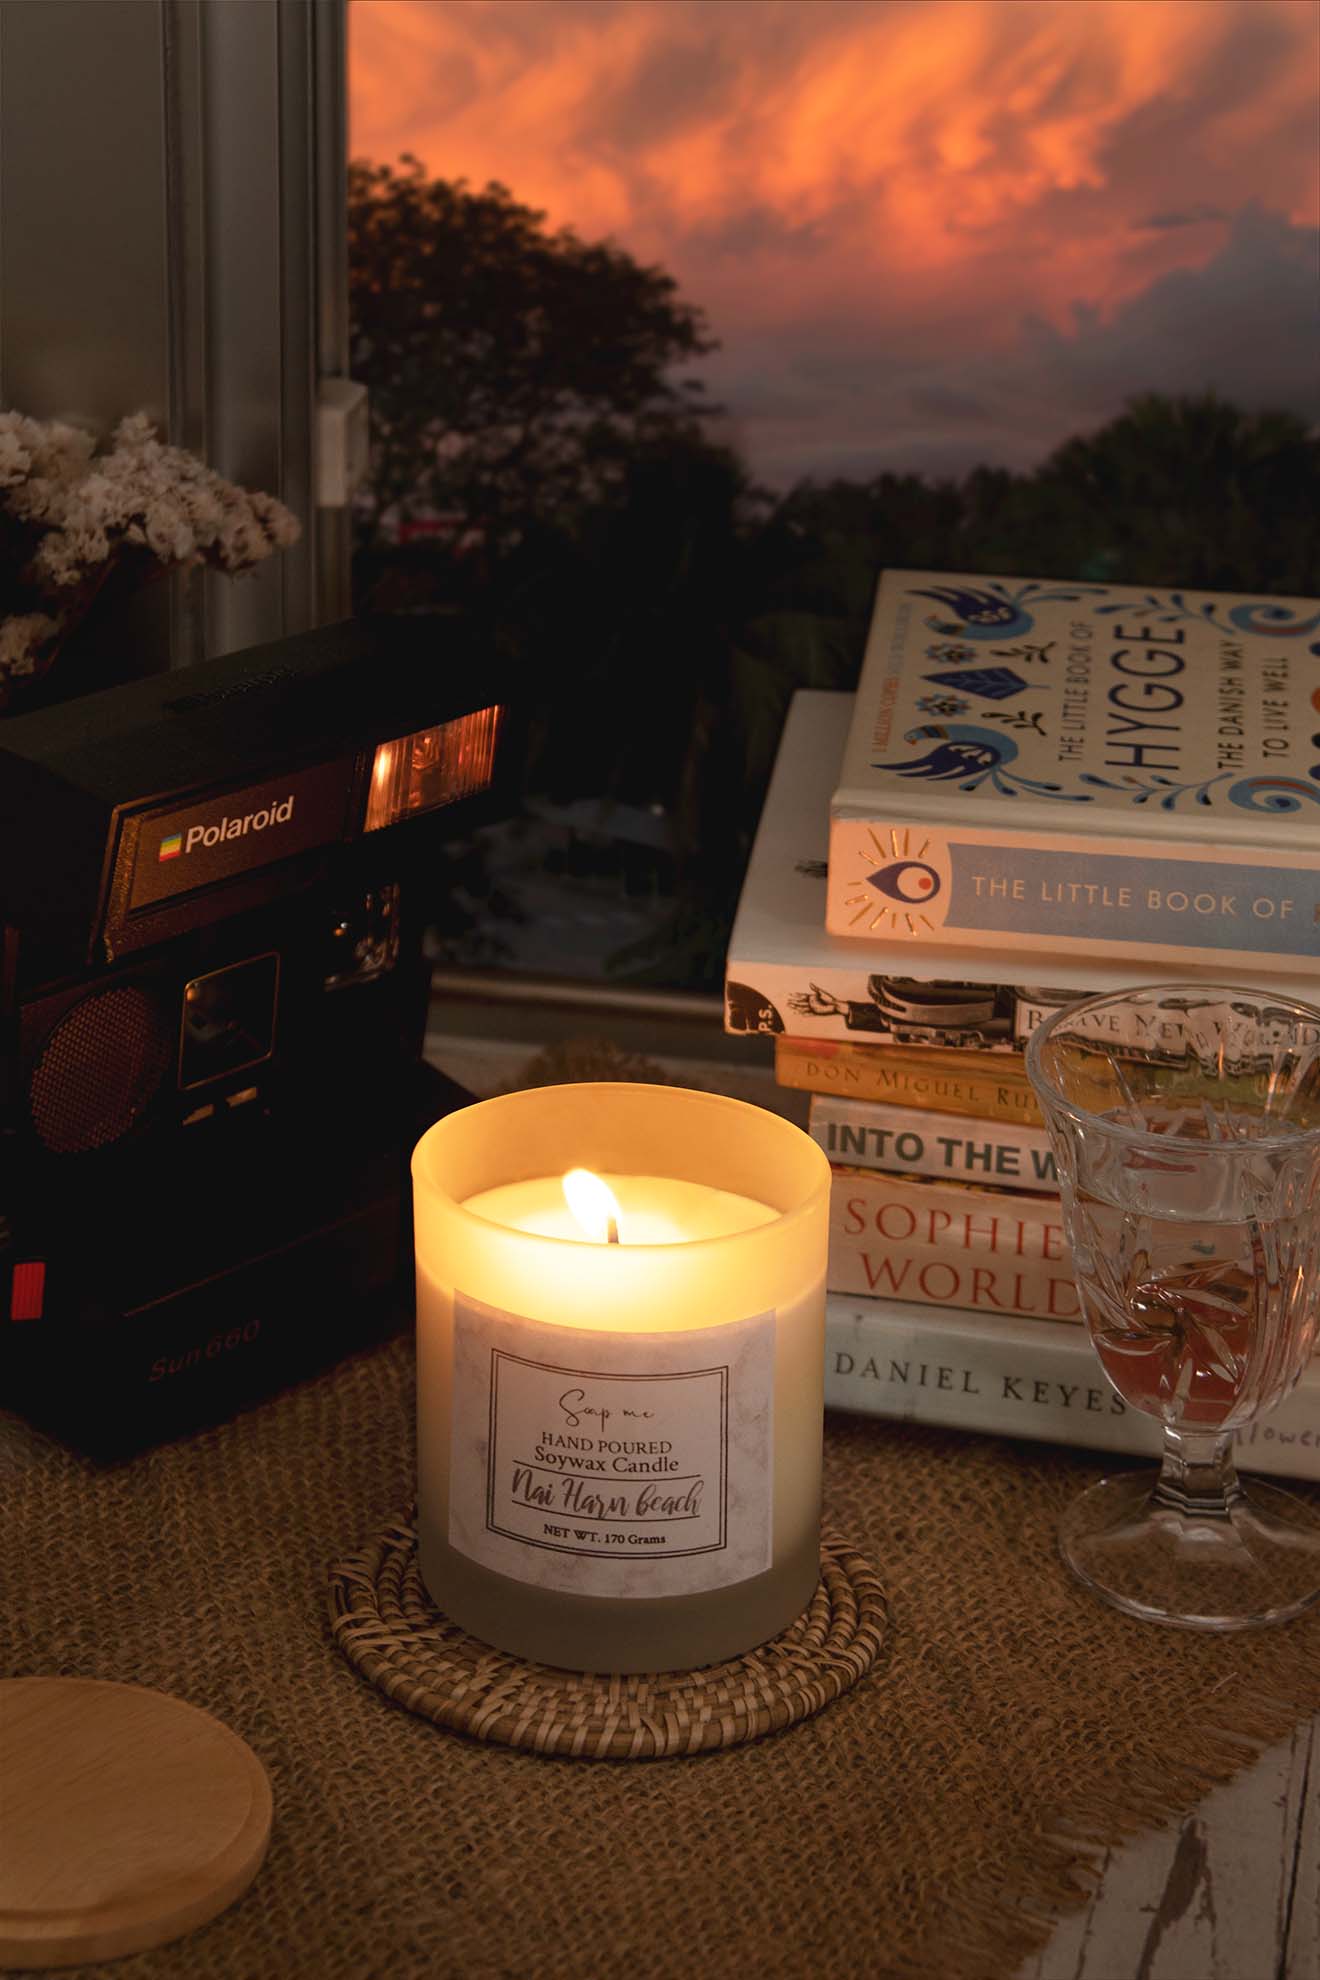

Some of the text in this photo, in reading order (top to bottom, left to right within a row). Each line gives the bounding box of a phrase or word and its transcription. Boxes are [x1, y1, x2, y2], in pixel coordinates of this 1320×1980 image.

[1058, 620, 1095, 762] THE LITTLE BOOK OF
[1104, 624, 1187, 771] HYGGE
[1217, 639, 1246, 770] THE DANISH WAY
[1262, 656, 1290, 759] TO LIVE WELL
[184, 796, 295, 854] Polaroid
[971, 876, 1025, 901] THE
[1041, 881, 1132, 908] LITTLE
[1147, 889, 1236, 918] BOOK
[1252, 897, 1294, 919] OF
[806, 1062, 860, 1082] DON
[876, 1069, 979, 1102] MIGUEL
[827, 1122, 925, 1162] INTO
[936, 1136, 1021, 1176] THE
[860, 1252, 1081, 1316] WORLD
[559, 1388, 655, 1432] Soap me
[834, 1351, 1127, 1416] DANIEL KEYES
[534, 1446, 680, 1474] Soywax Candle
[541, 1431, 673, 1454] HAND POURED
[512, 1469, 556, 1504] Nai
[561, 1477, 629, 1520] Harn
[543, 1523, 667, 1546] NET WT. 170 Grams
